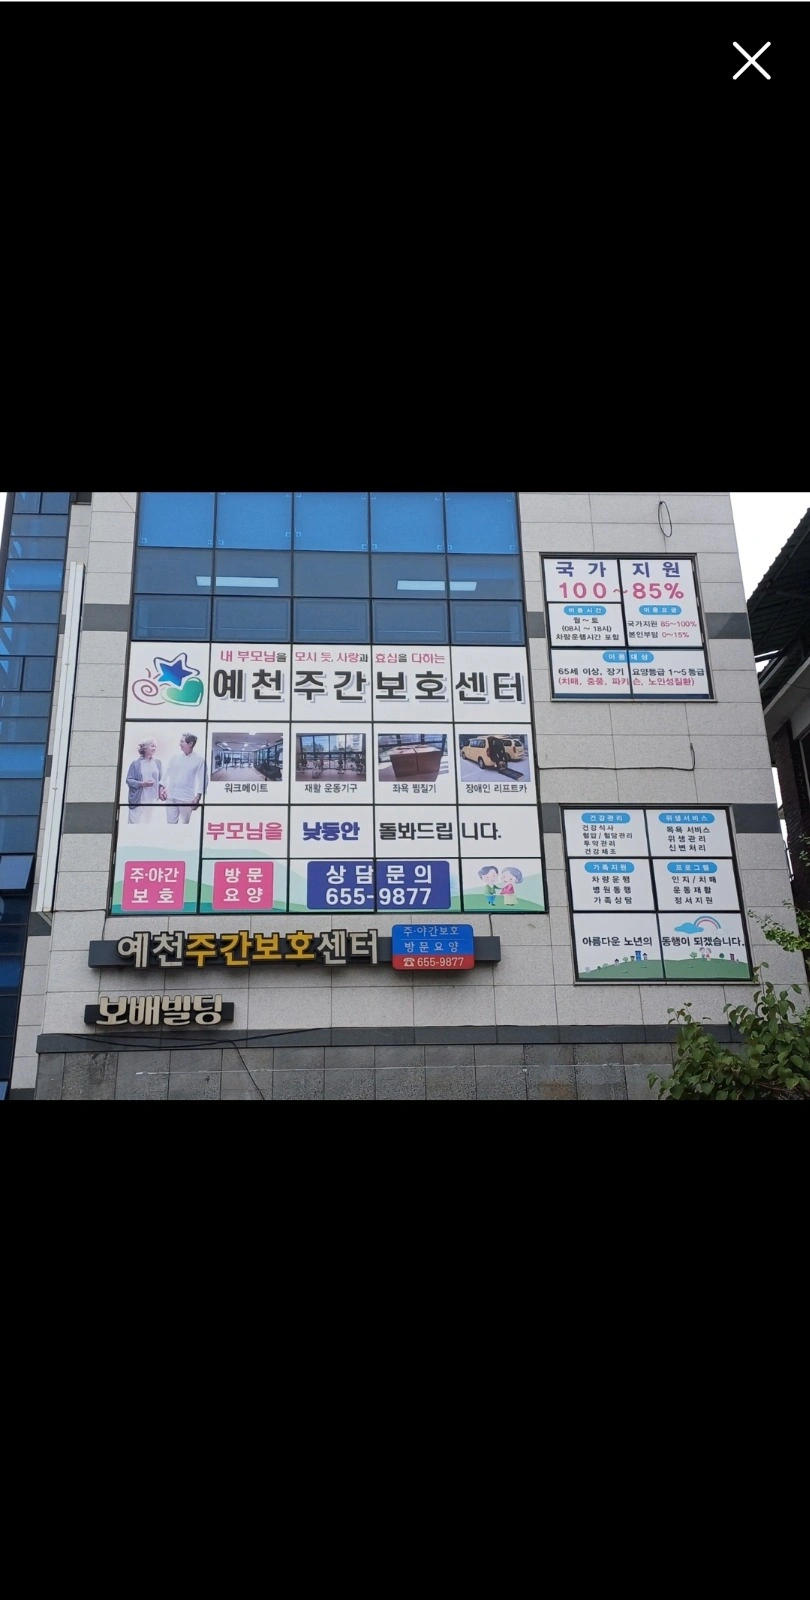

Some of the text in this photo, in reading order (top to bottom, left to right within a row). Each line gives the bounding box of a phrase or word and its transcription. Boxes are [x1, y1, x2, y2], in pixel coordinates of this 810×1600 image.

[627, 620, 658, 628] 국가지원
[604, 633, 620, 641] 포함
[628, 631, 659, 639] 본인부담
[220, 650, 233, 663] 내
[237, 650, 287, 663] 부모님을
[295, 651, 317, 663] 모시
[336, 652, 369, 663] 사랑과
[375, 652, 408, 664] 효심을
[411, 652, 446, 664] 다하는
[558, 667, 579, 676] 65세
[223, 783, 269, 793] 워크메이트
[304, 783, 359, 793] 재활 운동기구
[392, 783, 437, 794] 좌욕 찜질기
[465, 784, 528, 794] 장애인 리프트카
[206, 821, 283, 841] 부모님을
[325, 887, 432, 906] 655-9877
[582, 936, 746, 947] 아름다운 노년의 동행이 되겠습니다.
[116, 929, 379, 968] 예천주간보호센터
[416, 956, 465, 968] 655-9877
[95, 995, 223, 1026] 보배빌딩
